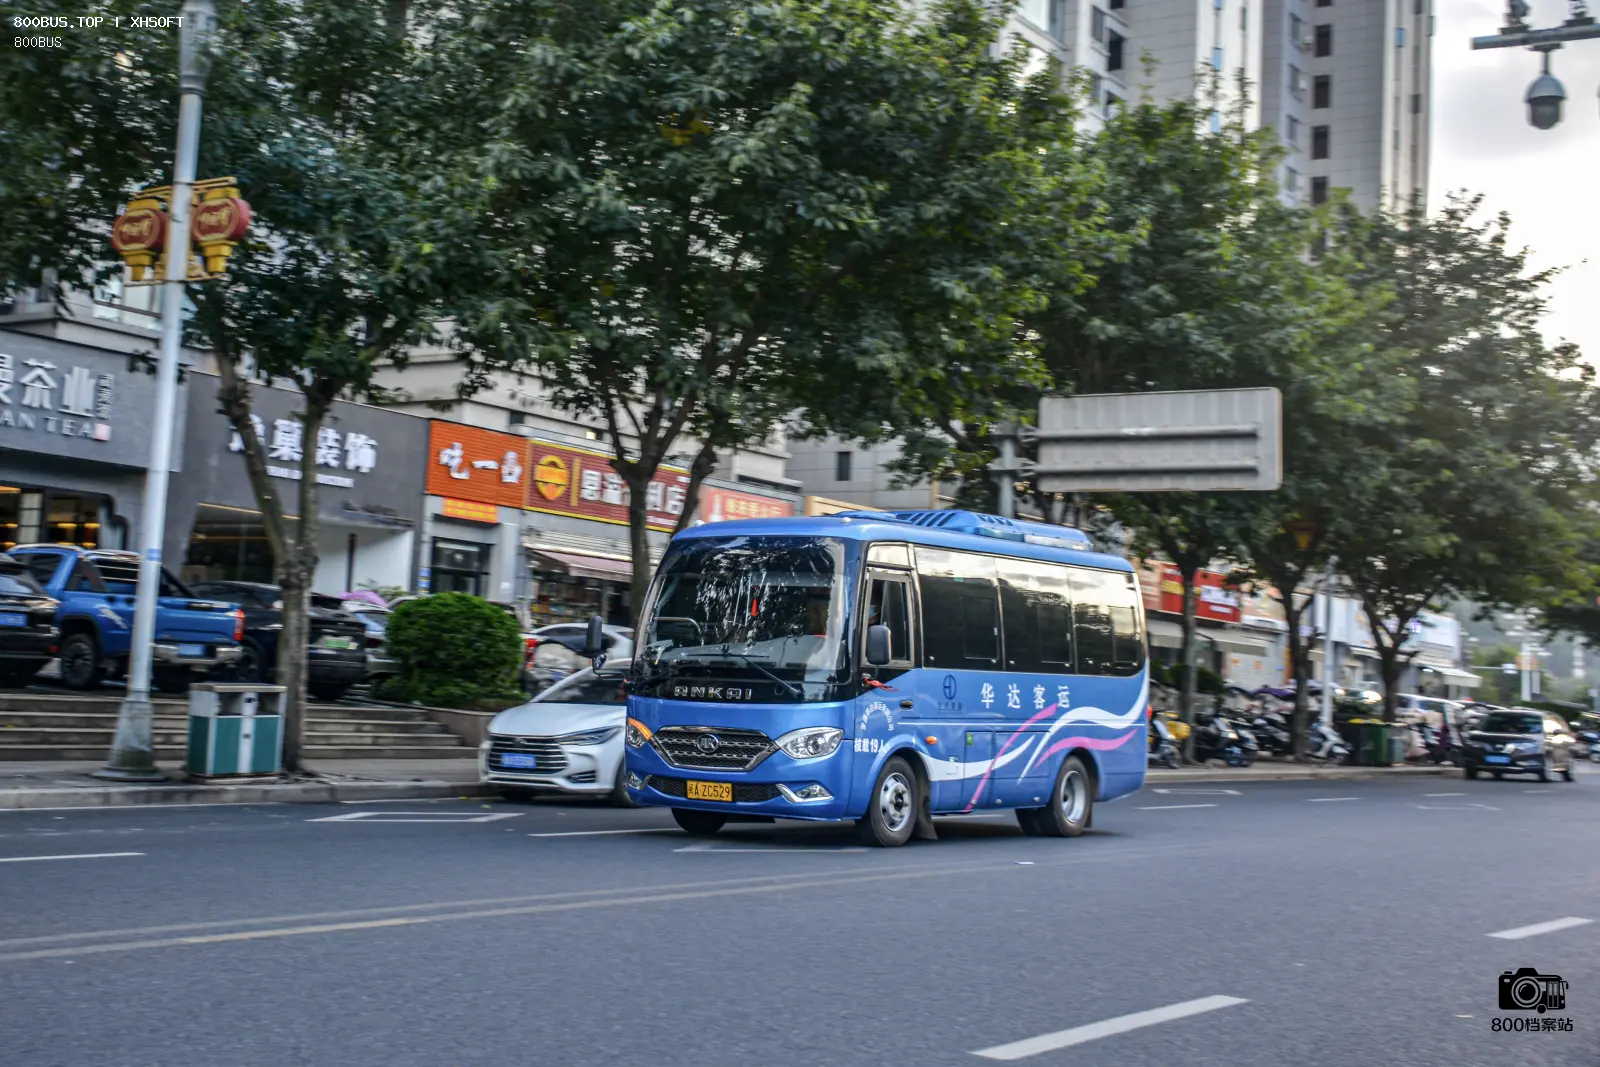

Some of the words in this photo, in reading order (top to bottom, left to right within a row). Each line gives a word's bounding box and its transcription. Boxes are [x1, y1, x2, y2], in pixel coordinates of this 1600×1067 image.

[44, 416, 94, 439] TEA
[674, 685, 752, 700] ANKAI
[980, 682, 1070, 710] 华达客运
